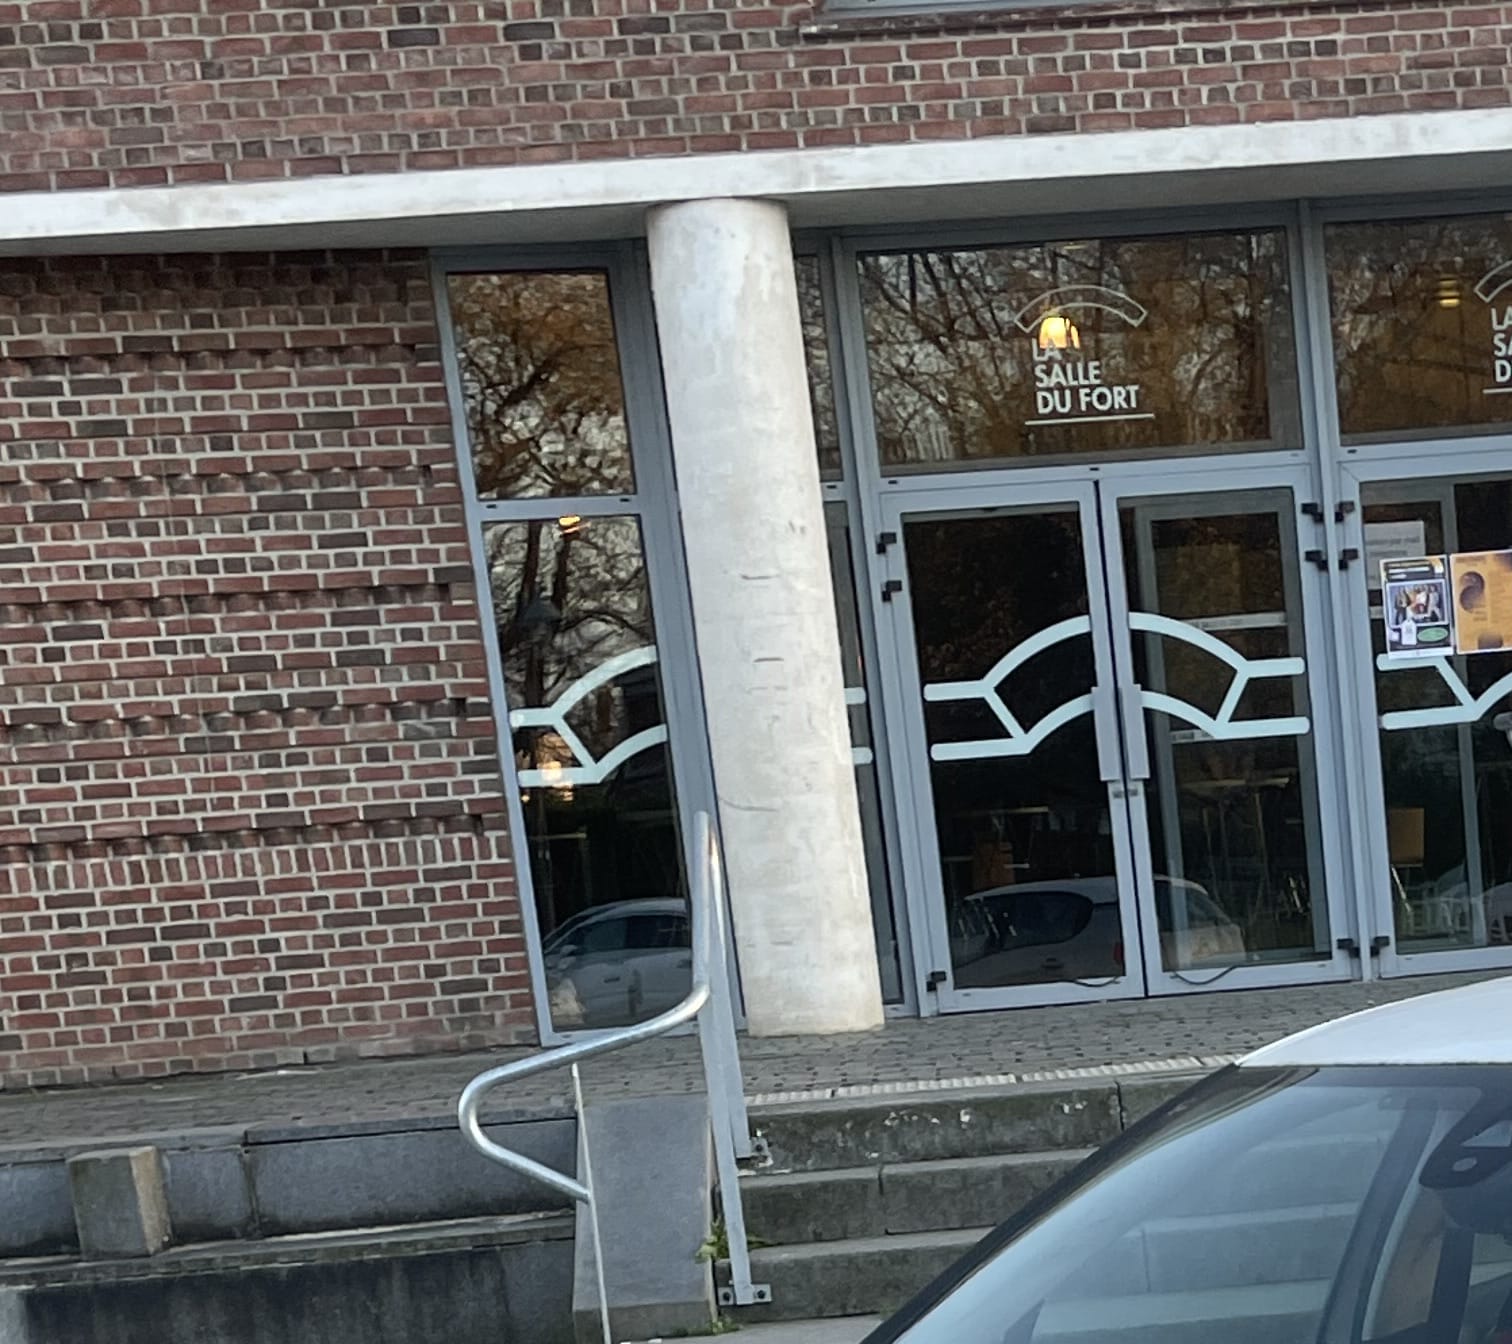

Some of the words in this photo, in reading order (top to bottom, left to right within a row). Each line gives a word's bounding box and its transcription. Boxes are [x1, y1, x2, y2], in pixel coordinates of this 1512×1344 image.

[1031, 337, 1062, 361] LA
[1034, 360, 1102, 388] SALLE
[1036, 389, 1072, 414] DU
[1079, 384, 1139, 412] FORT
